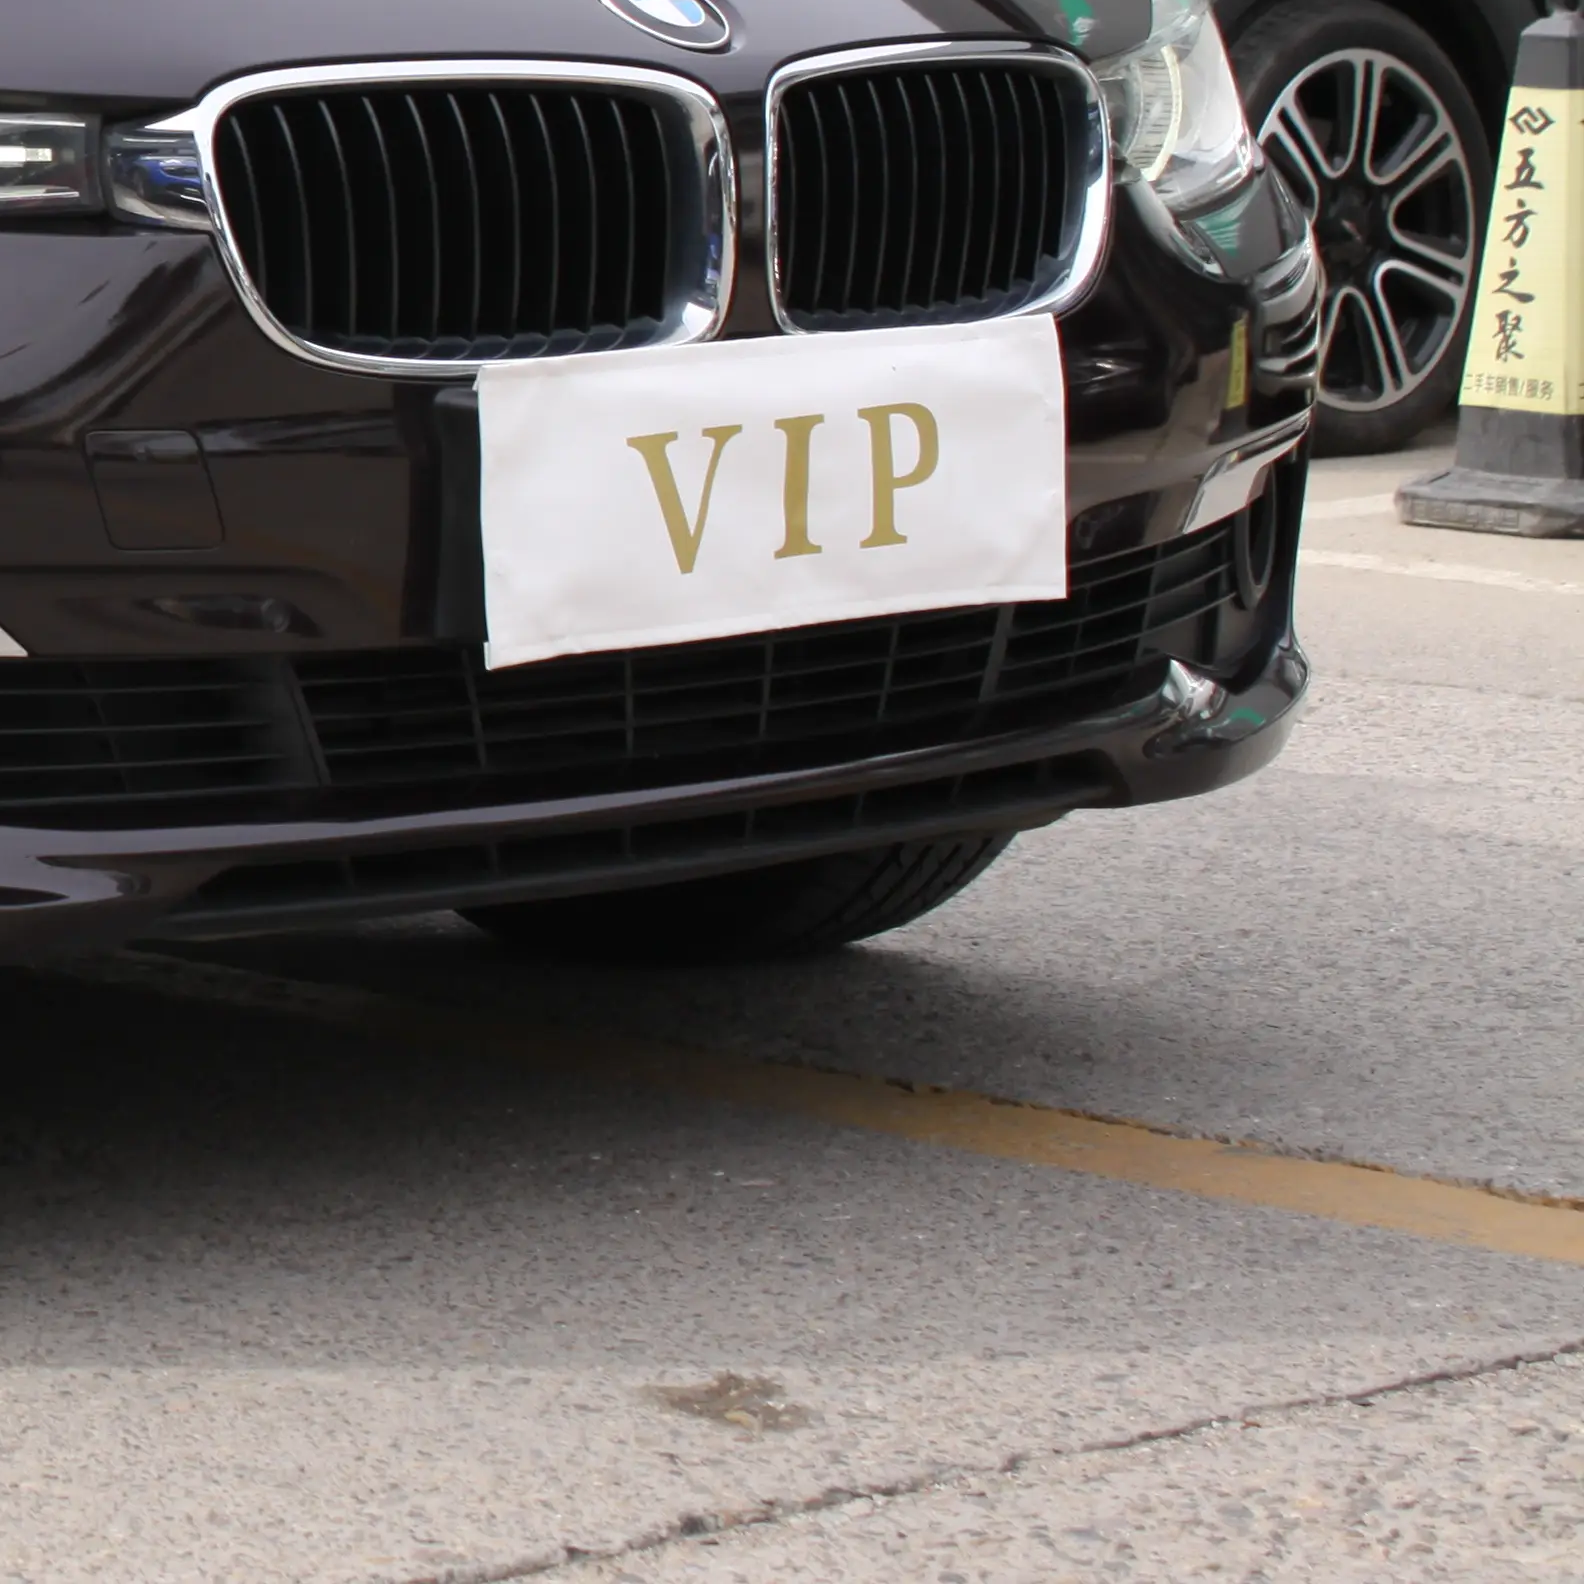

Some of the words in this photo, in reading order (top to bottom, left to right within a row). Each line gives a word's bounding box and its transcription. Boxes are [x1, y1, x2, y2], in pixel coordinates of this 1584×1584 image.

[1491, 146, 1546, 365] 五方之聚
[625, 400, 941, 576] VIP
